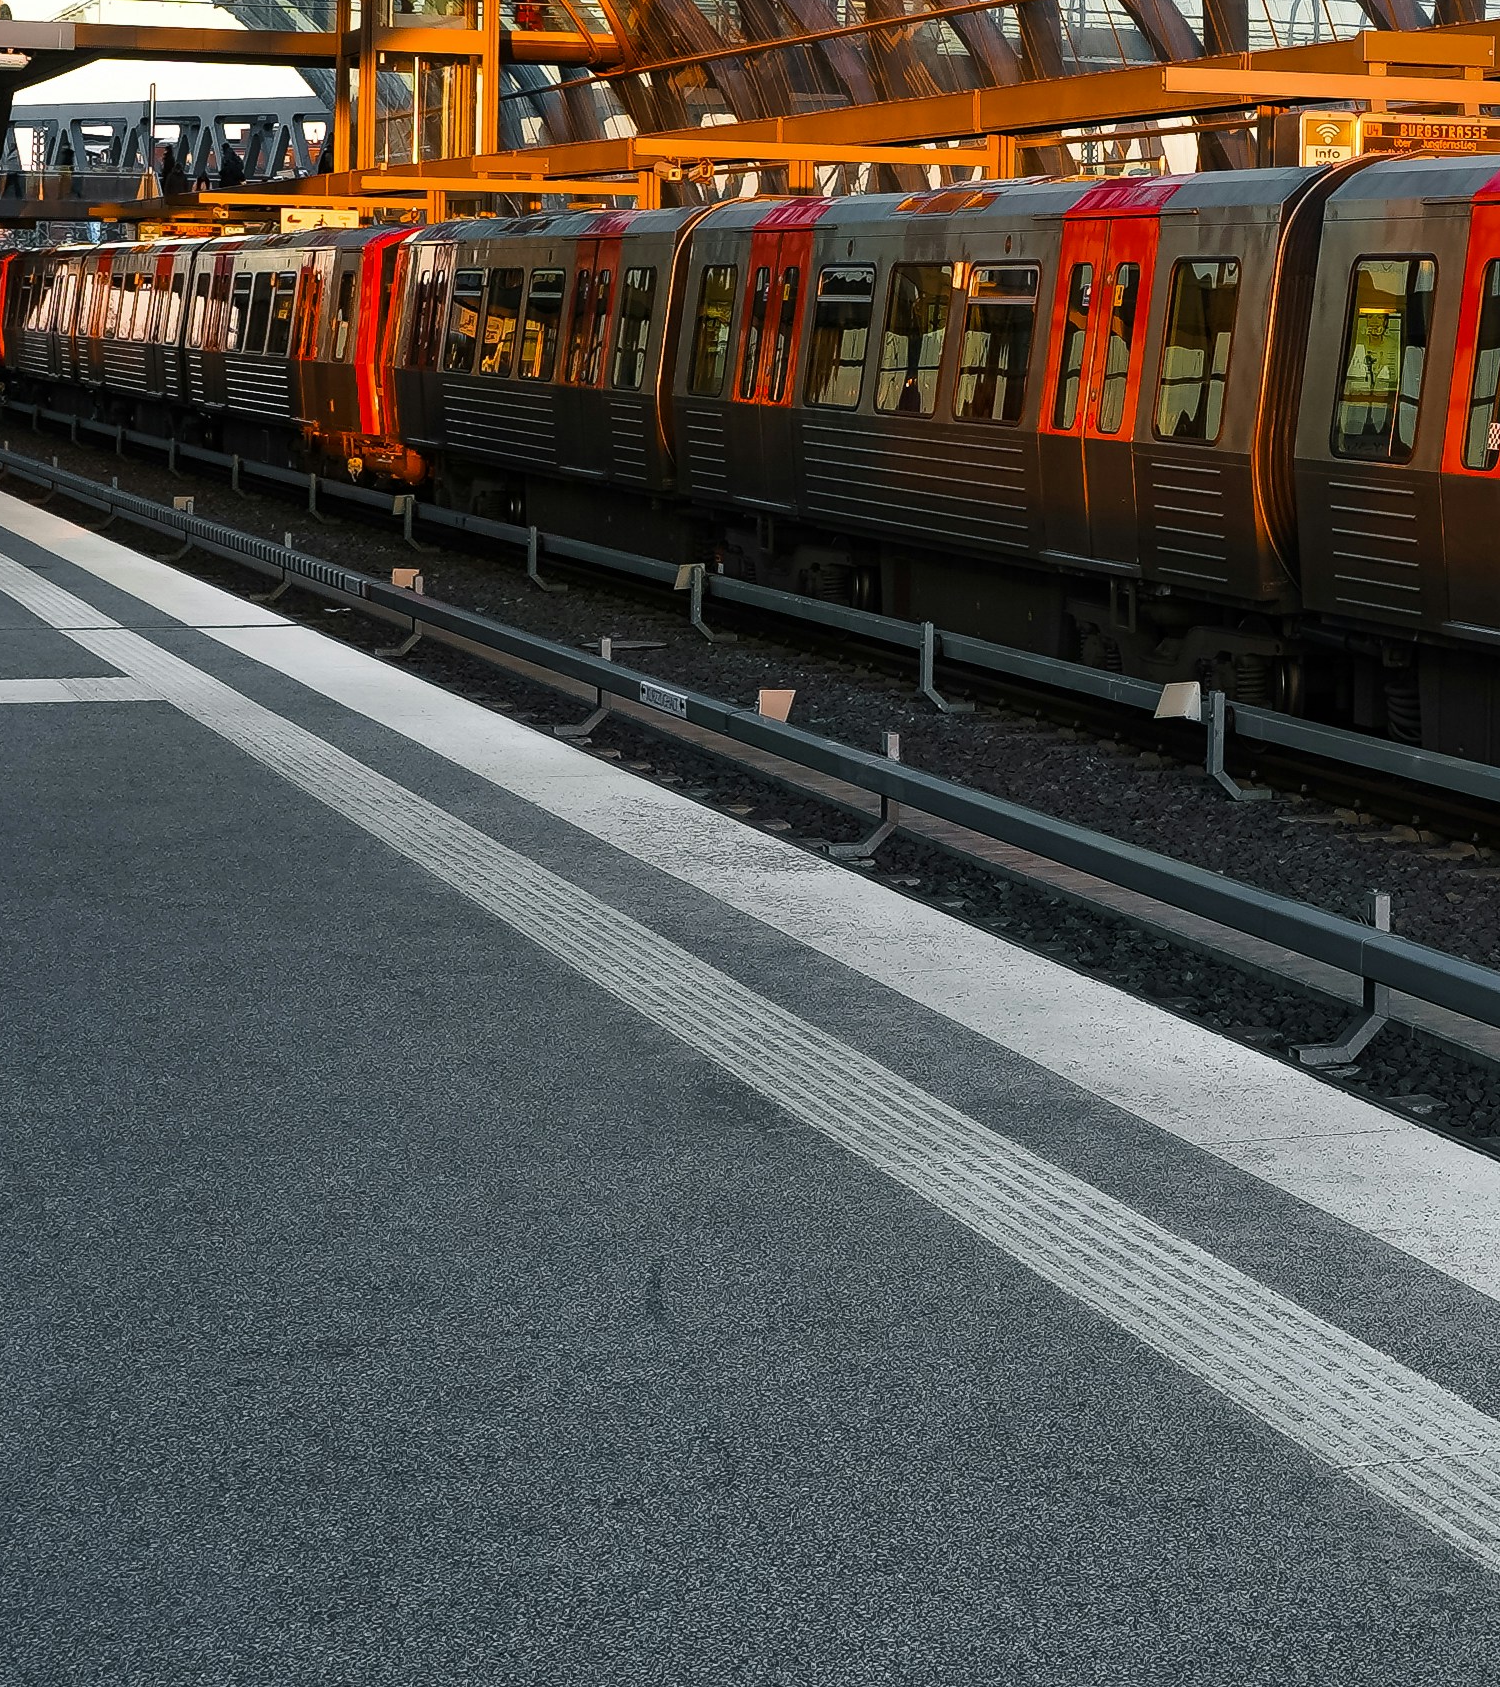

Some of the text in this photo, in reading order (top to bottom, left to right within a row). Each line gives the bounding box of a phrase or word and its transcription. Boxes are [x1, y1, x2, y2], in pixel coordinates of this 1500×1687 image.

[1366, 123, 1488, 140] U4 BURGSTRASSE
[1315, 148, 1340, 159] Info
